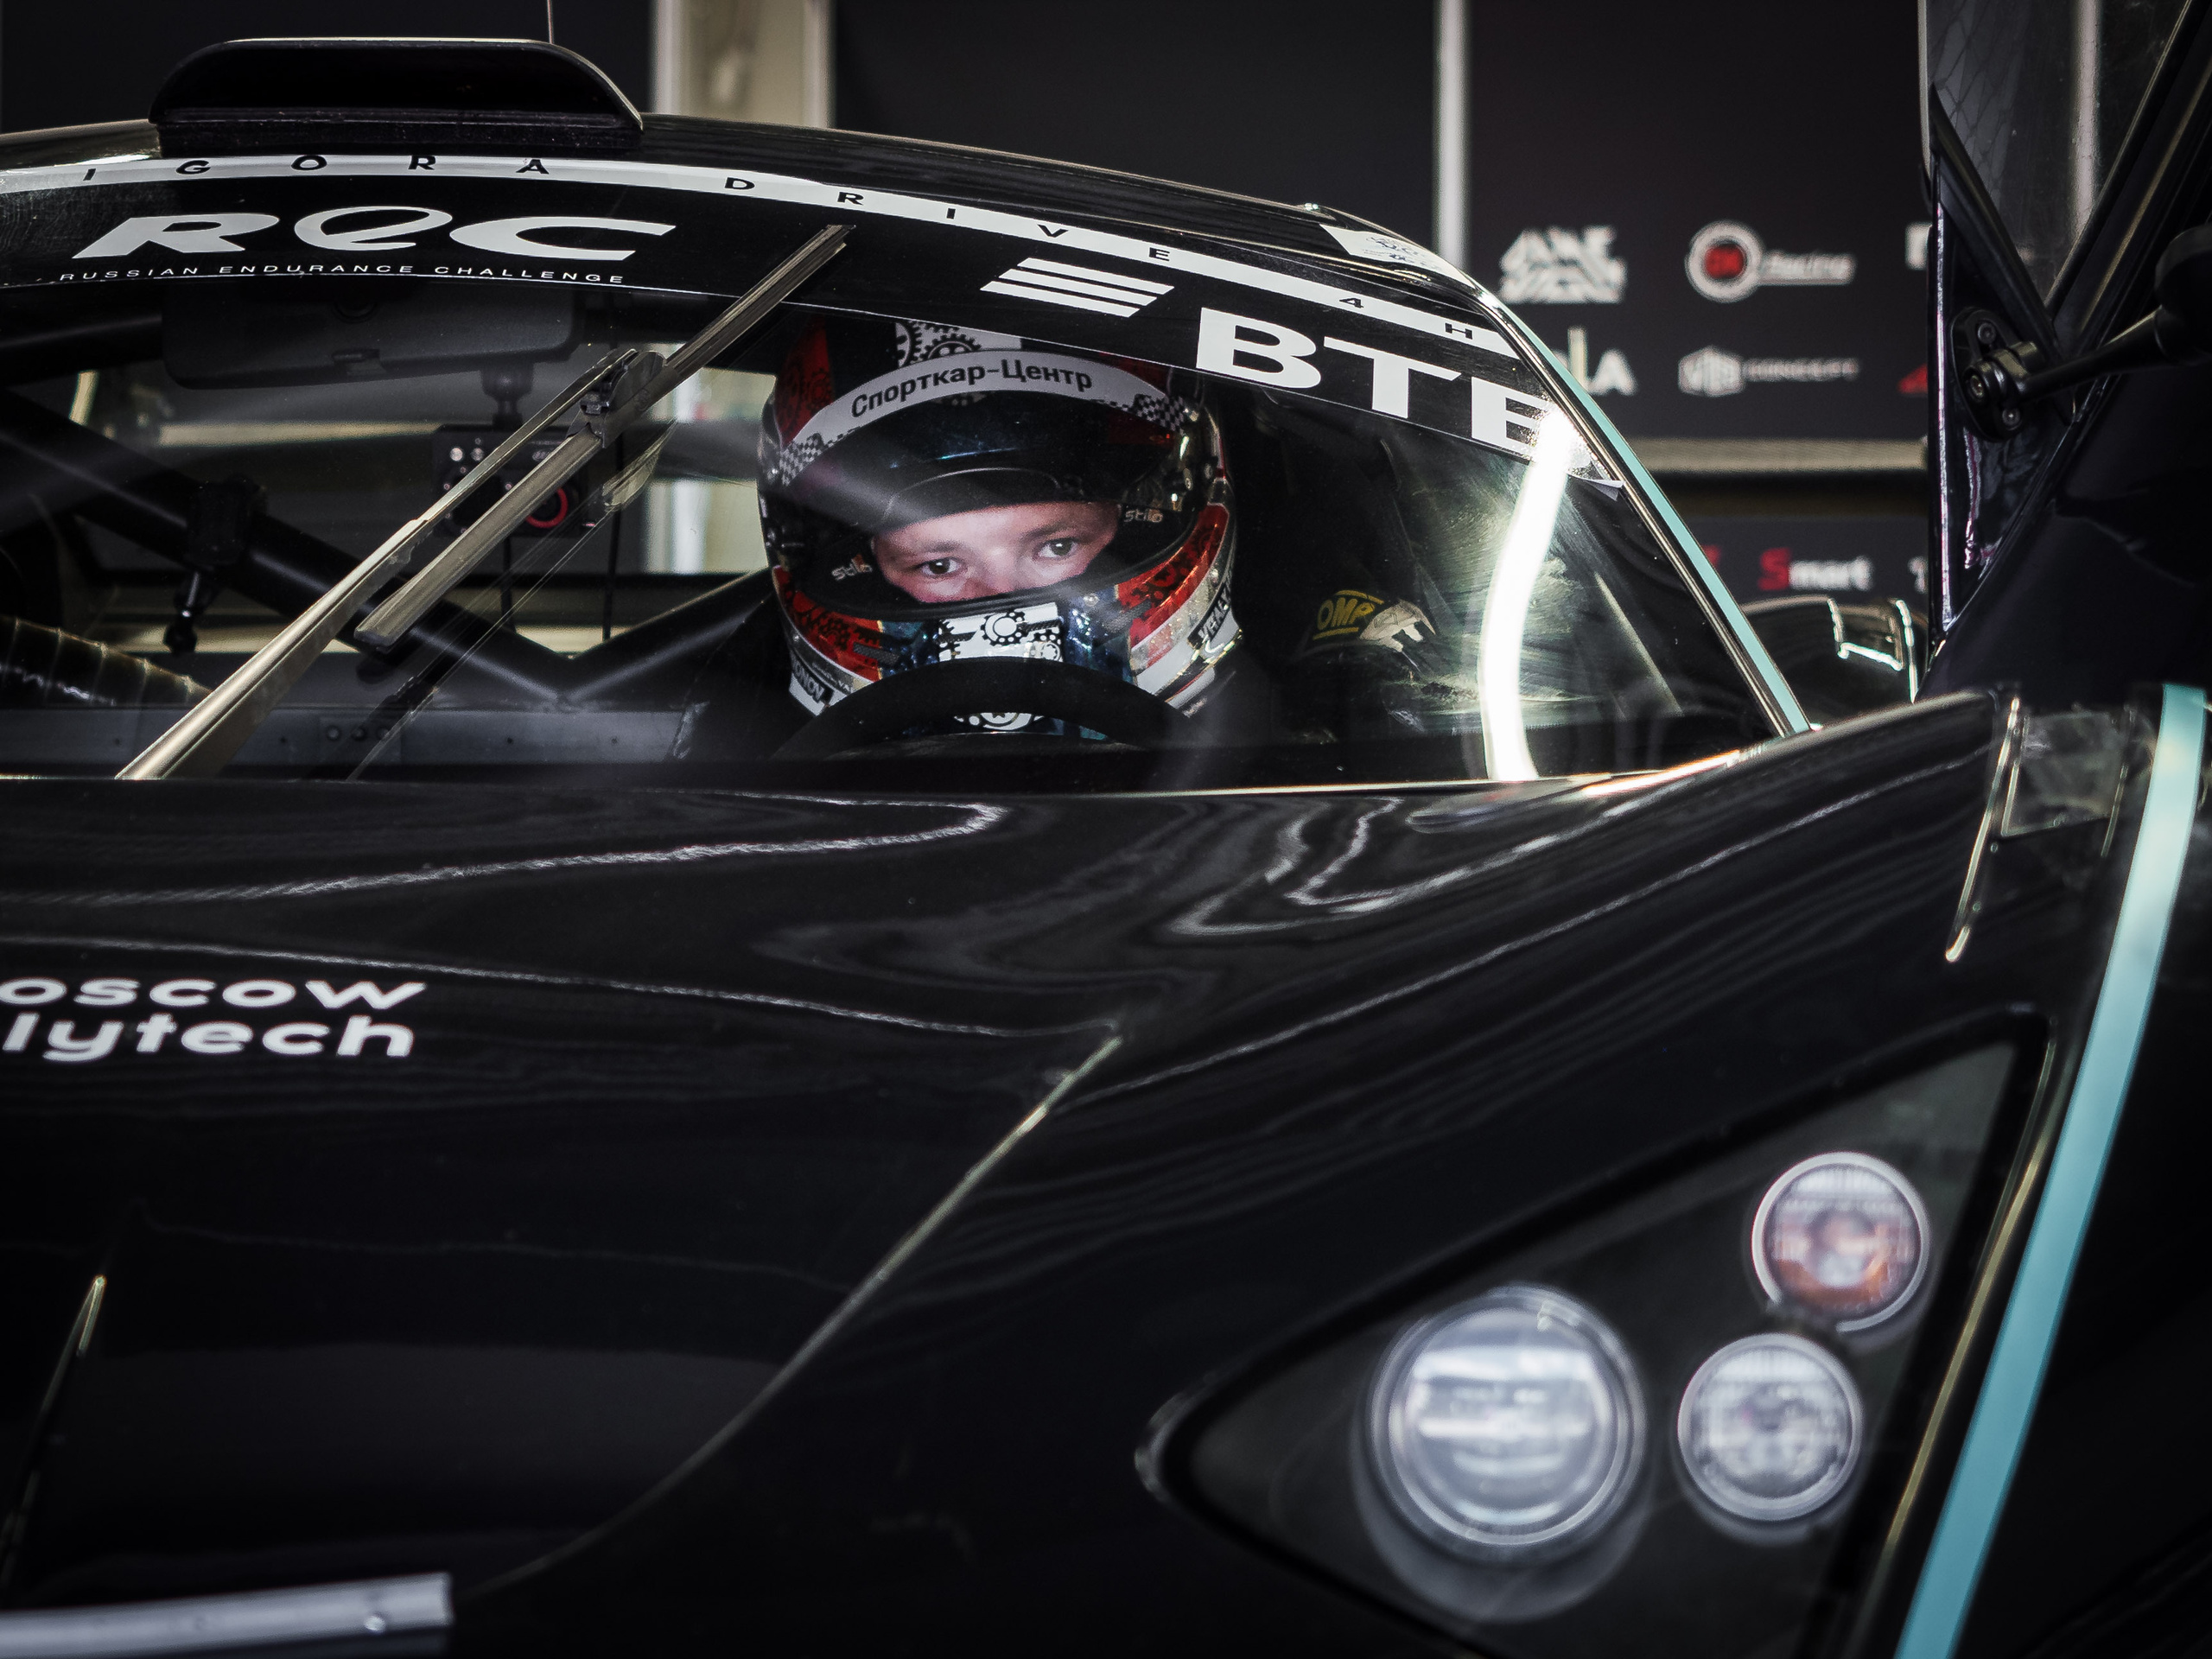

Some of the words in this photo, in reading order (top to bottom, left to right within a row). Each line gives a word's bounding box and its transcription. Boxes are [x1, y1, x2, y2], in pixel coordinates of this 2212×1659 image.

[82, 154, 550, 181] IGORA
[724, 176, 1171, 262] DRIVE
[60, 267, 198, 282] RUSSIAN
[219, 264, 415, 275] ENDURANCE
[435, 266, 624, 284] CHALLENGE
[851, 359, 1092, 418] Спорткар-Центр
[1317, 596, 1376, 631] OMP
[2, 1012, 415, 1063] lytech
